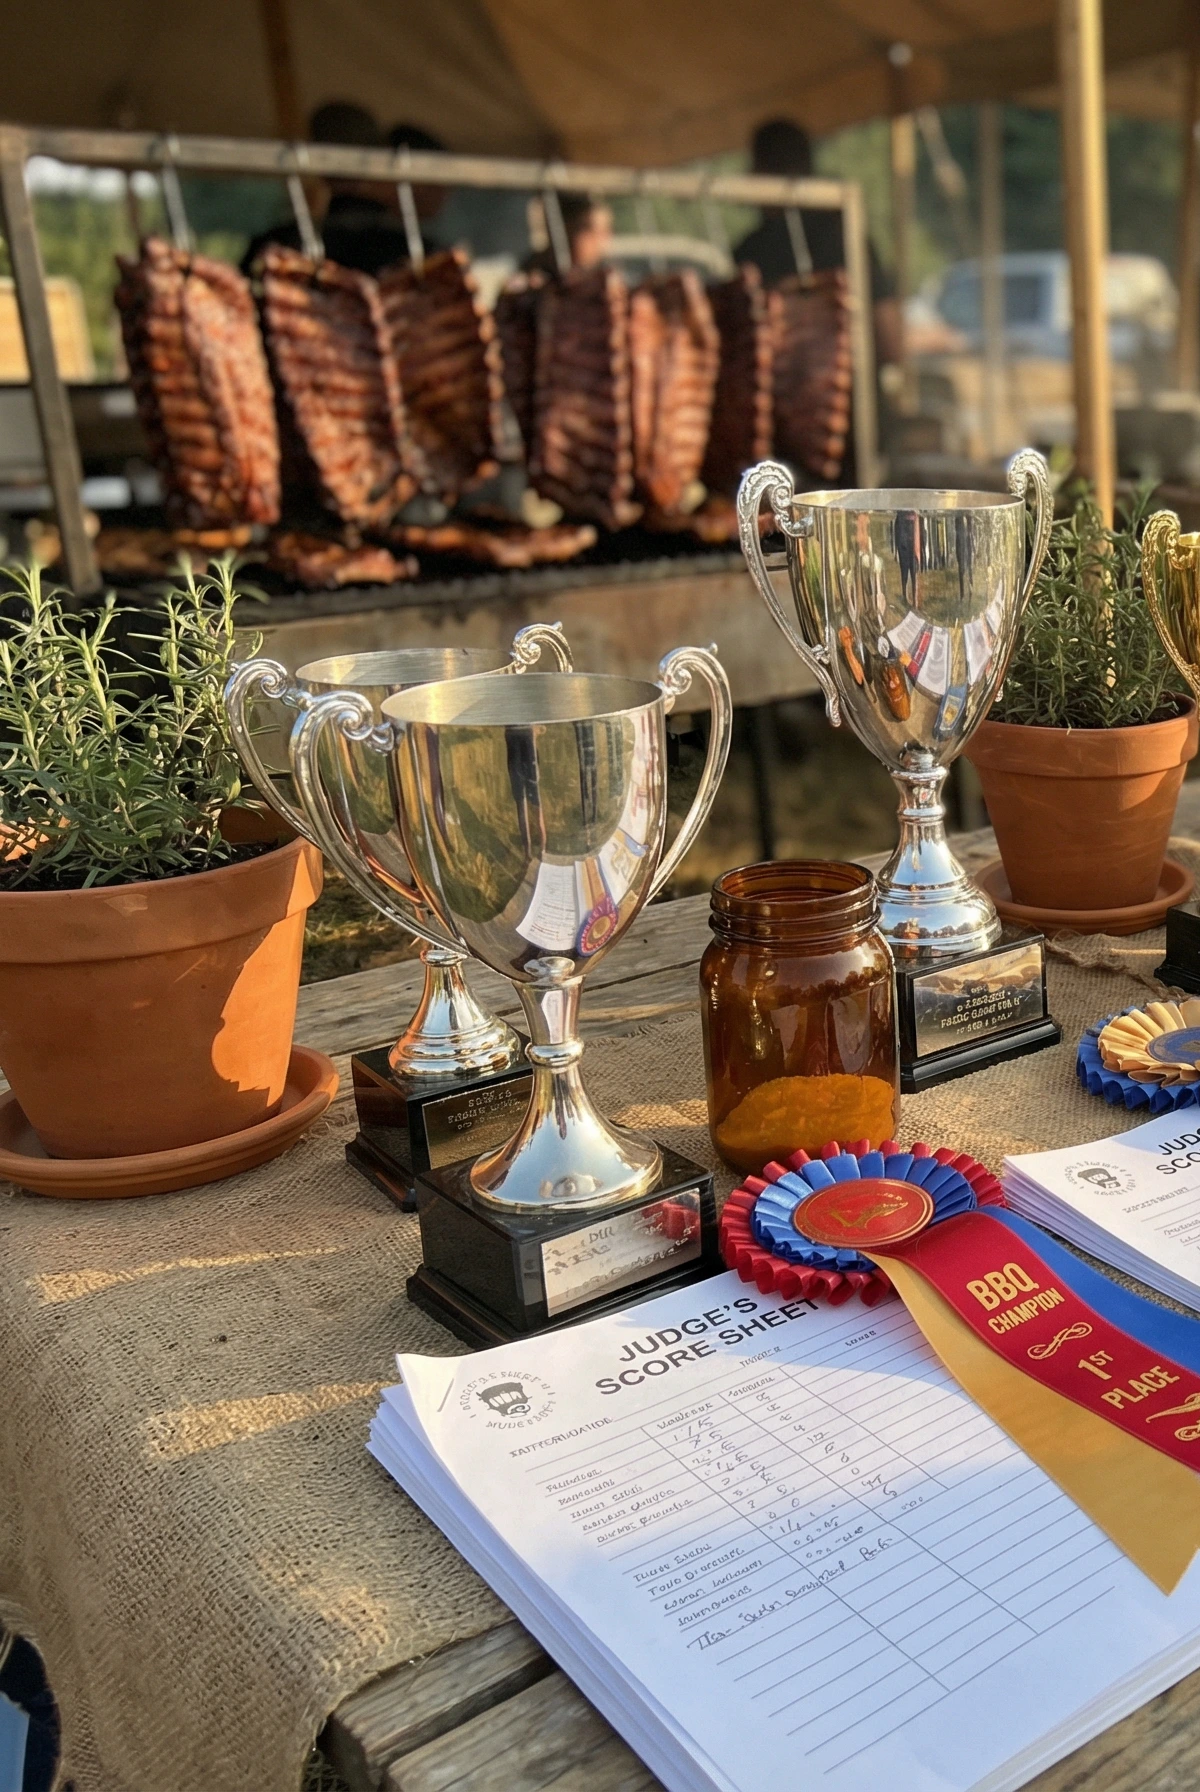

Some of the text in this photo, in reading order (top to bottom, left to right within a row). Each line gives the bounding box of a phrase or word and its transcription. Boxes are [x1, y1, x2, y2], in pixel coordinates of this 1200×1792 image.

[965, 1262, 1040, 1312] BBQ
[987, 1287, 1066, 1335] CHAMPION
[594, 1339, 718, 1396] SCORE
[717, 1297, 820, 1346] SHEET
[618, 1296, 758, 1363] JUDGE'S
[1077, 1350, 1114, 1381] 1ST
[1100, 1365, 1181, 1410] PLACE
